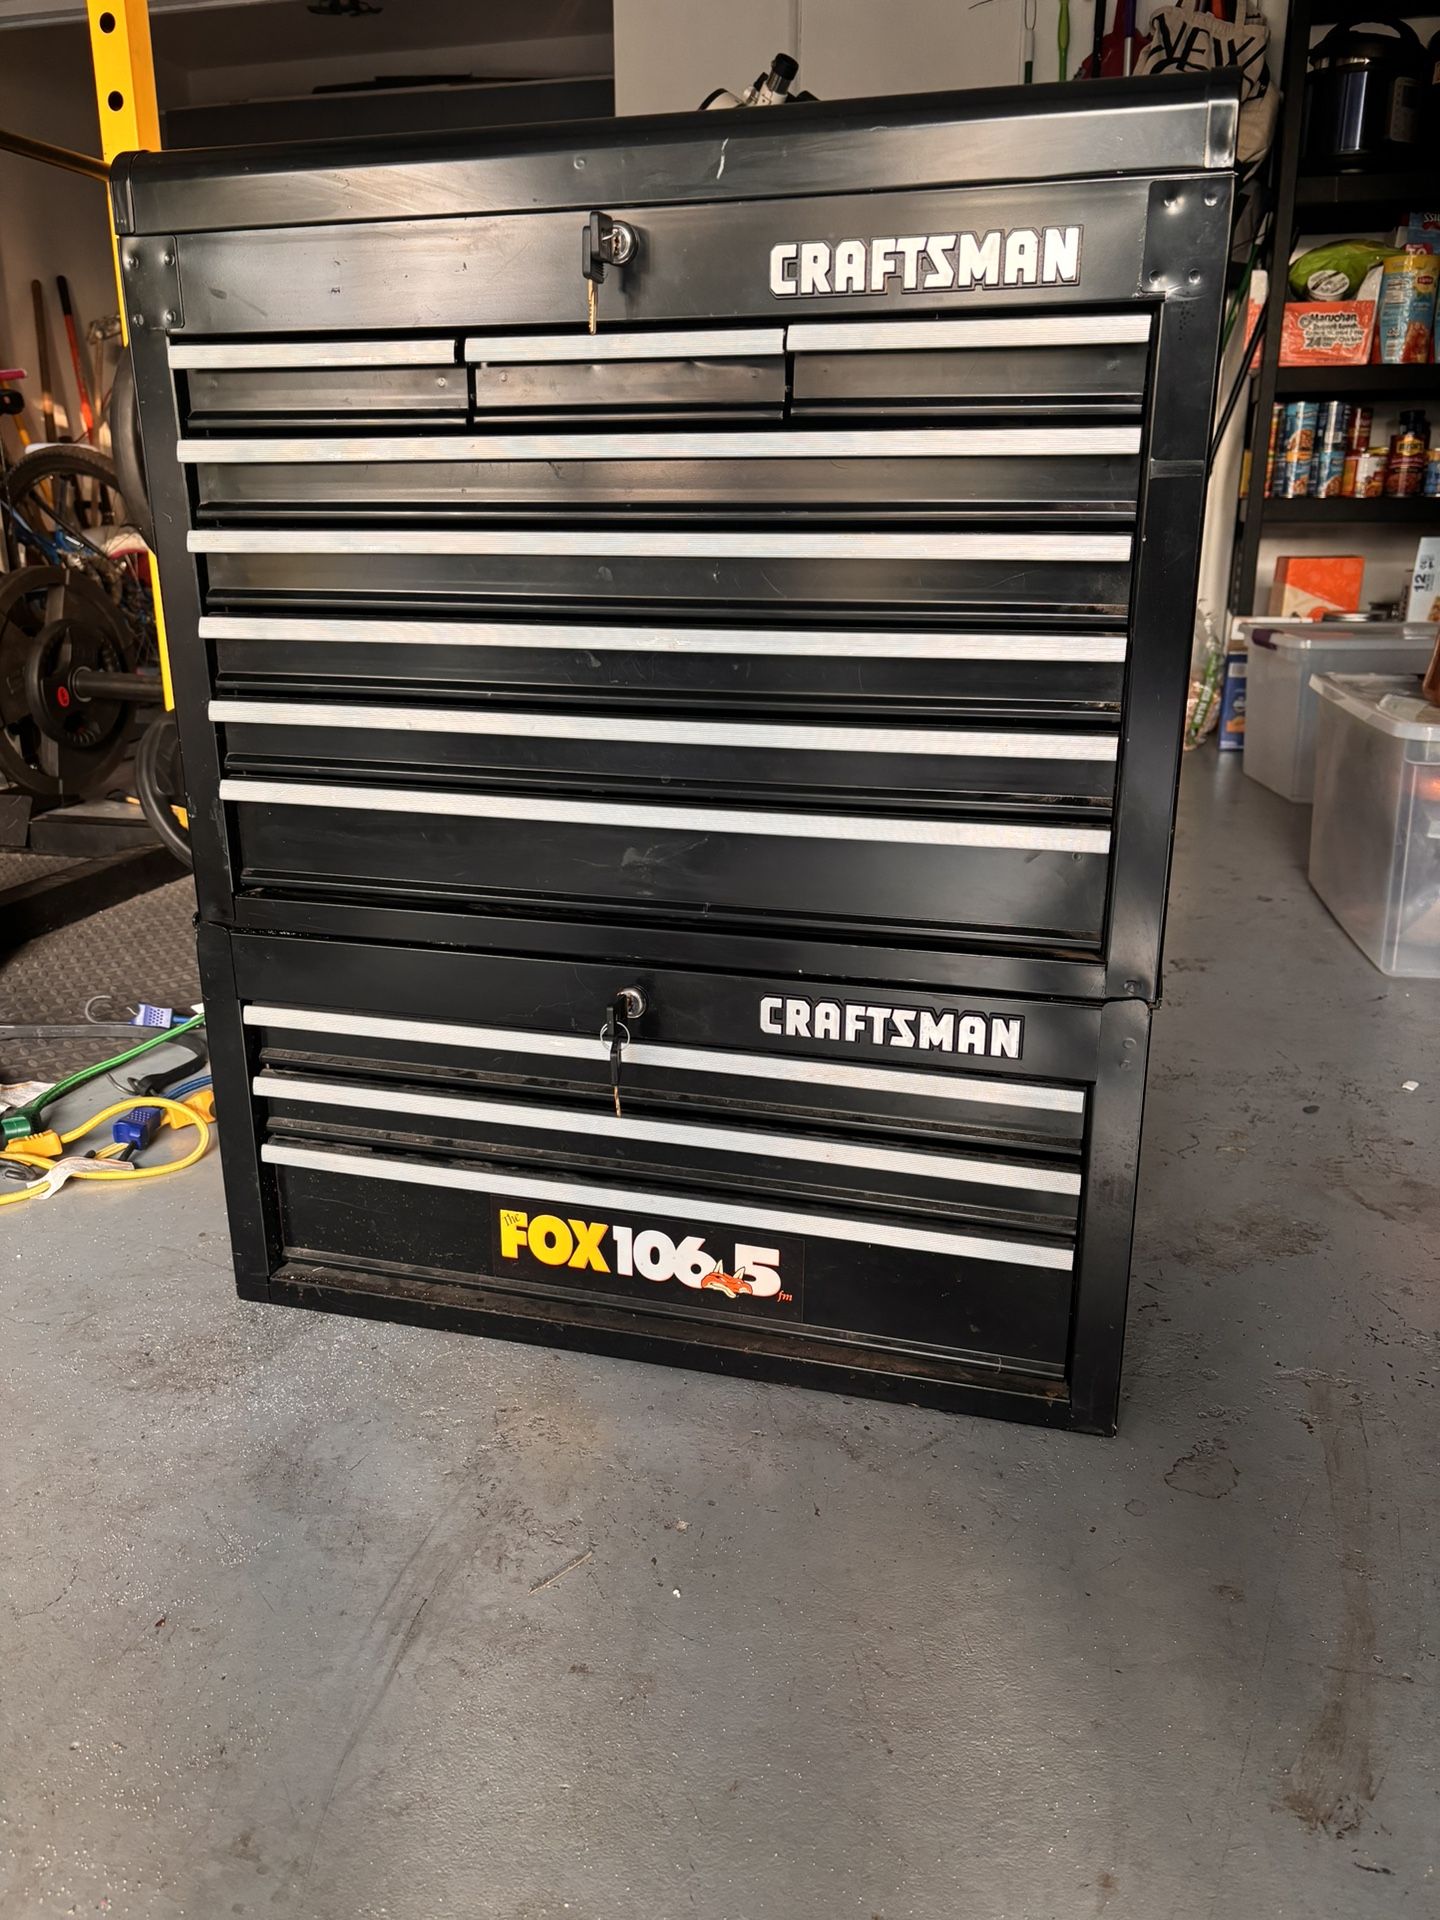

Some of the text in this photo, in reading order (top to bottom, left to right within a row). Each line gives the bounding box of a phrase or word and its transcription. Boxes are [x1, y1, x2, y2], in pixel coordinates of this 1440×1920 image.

[769, 226, 1082, 297] CRAFTSMAN
[1414, 574, 1426, 593] 12
[760, 994, 1023, 1059] CRAFTSMAN
[500, 1209, 611, 1274] FOX
